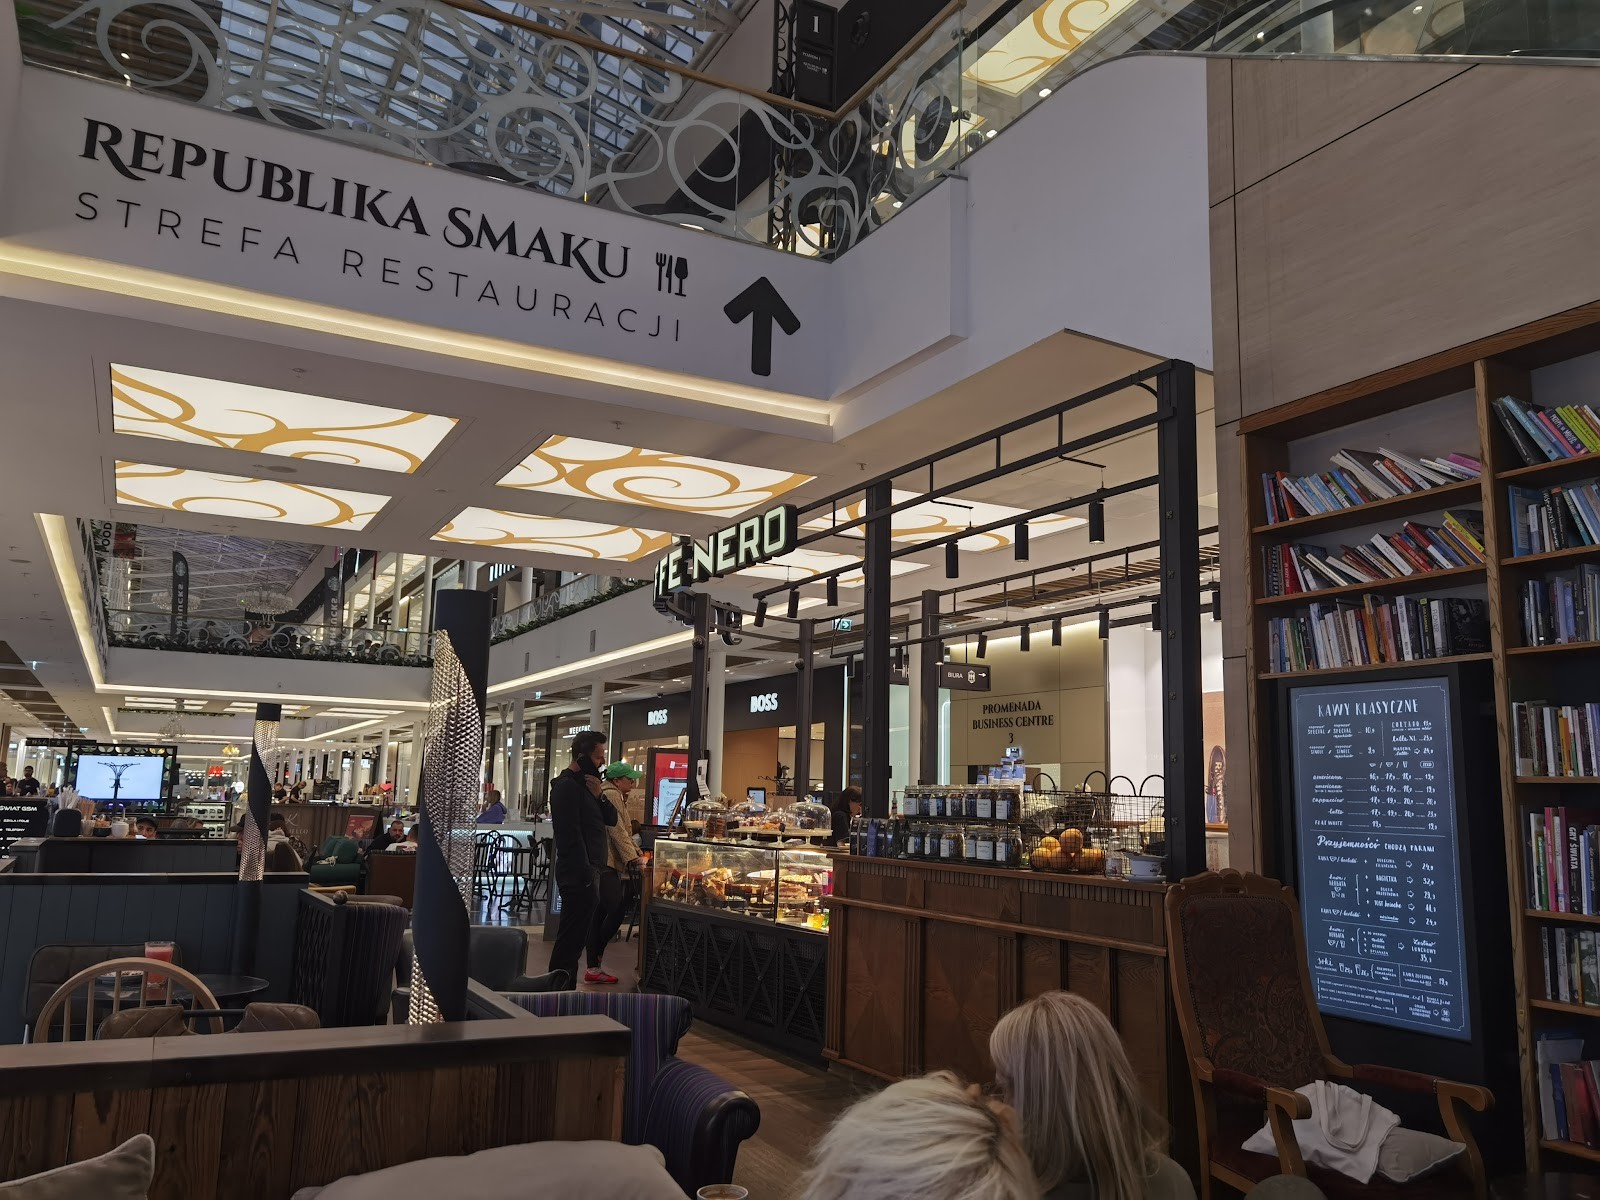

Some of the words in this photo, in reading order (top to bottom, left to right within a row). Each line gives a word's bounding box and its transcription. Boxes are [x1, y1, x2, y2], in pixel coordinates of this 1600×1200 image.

[83, 118, 430, 236] REPUBLIKA
[443, 207, 630, 285] SMAKU
[75, 192, 302, 264] STREFA
[342, 248, 683, 342] RESTAURACJI
[654, 534, 683, 604] FFÈ
[693, 505, 787, 581] NERO
[750, 693, 779, 713] BOSS
[982, 700, 1042, 714] PROMENADA
[1318, 702, 1350, 717] KAWY
[1356, 698, 1418, 716] KLASYCZNE
[647, 709, 668, 726] BOSS
[972, 718, 1014, 730] BUSINESS
[1015, 715, 1054, 728] CENTRE
[1008, 733, 1014, 744] 3
[1568, 826, 1577, 842] GRY
[1317, 835, 1381, 849] Przyjemności
[1384, 844, 1407, 853] CHODZĄ
[1570, 842, 1580, 870] ŚWIATA
